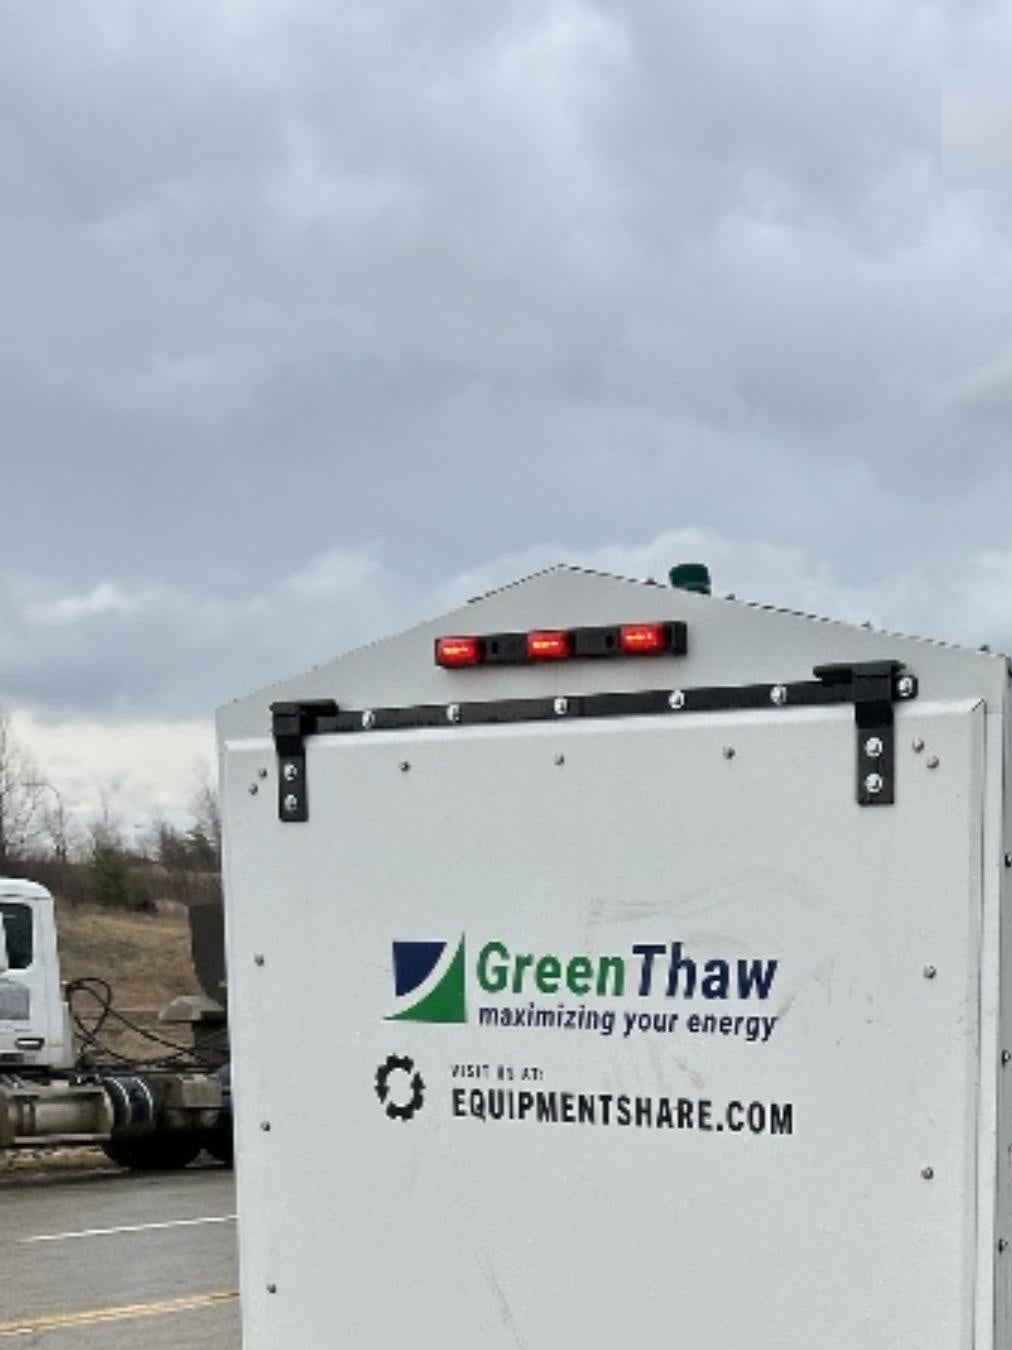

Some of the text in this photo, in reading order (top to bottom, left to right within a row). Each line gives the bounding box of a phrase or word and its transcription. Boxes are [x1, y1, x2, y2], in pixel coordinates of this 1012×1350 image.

[475, 940, 779, 1000] GreenThaw
[478, 1002, 778, 1042] maximizing your energy
[450, 1064, 490, 1078] VISIT
[451, 1087, 793, 1135] EQUIPMENTSHARE.COM
